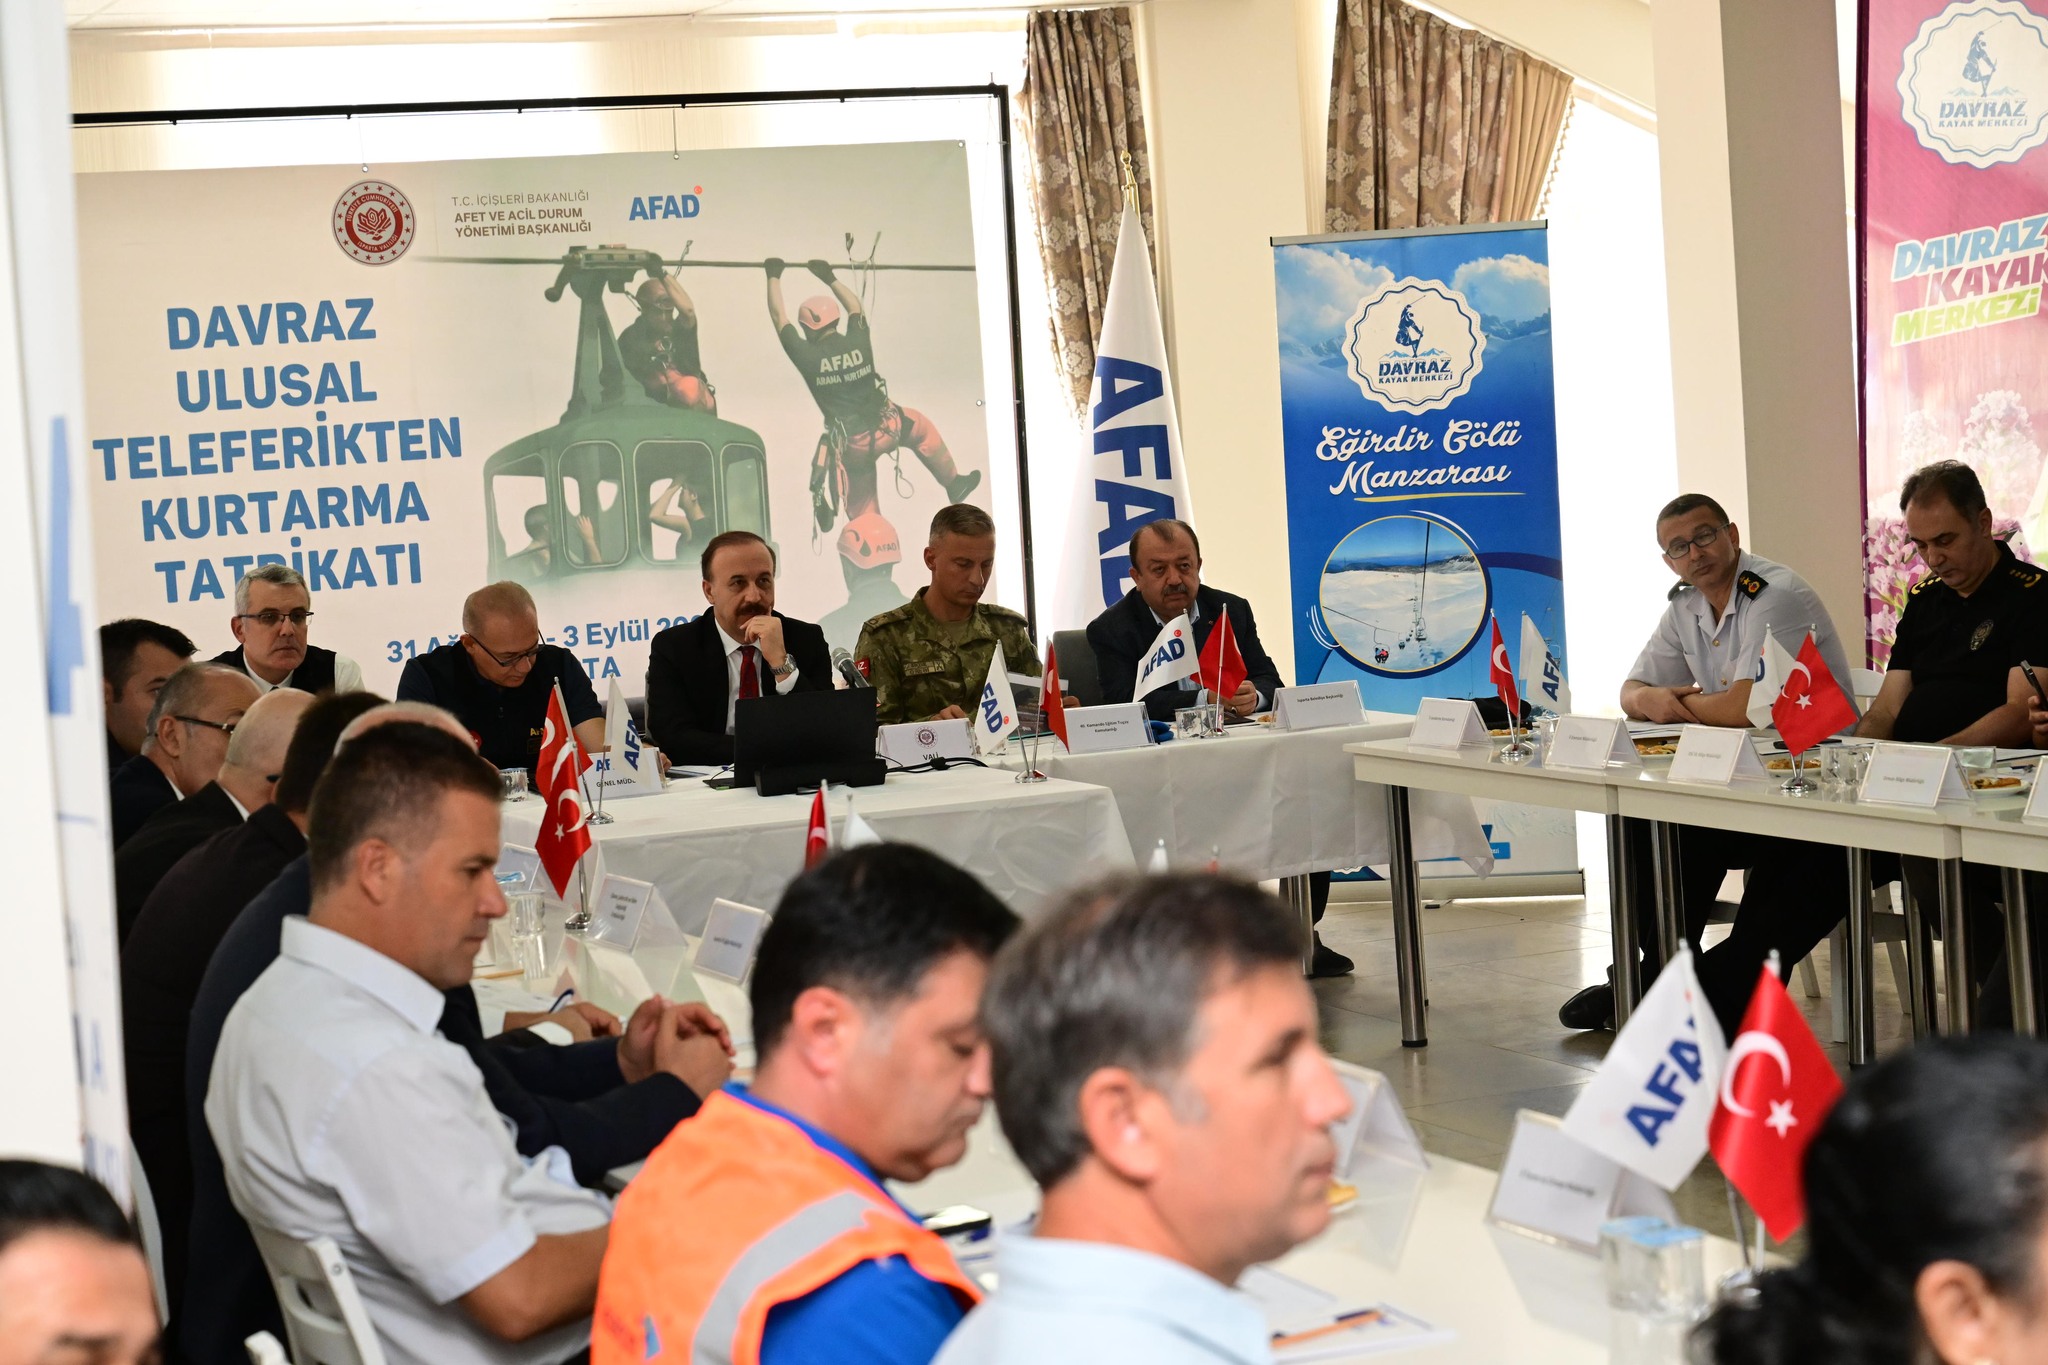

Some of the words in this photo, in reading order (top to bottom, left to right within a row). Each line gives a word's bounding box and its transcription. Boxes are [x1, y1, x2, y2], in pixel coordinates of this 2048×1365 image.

[1939, 99, 2028, 119] DAVRAZ
[1939, 119, 1975, 128] KAYAK
[451, 195, 474, 206] T.C.
[527, 189, 590, 204] BAKANLIĞI
[454, 211, 486, 224] AFET
[488, 210, 506, 222] VE
[507, 207, 536, 221] ACİL
[538, 207, 584, 220] DURUM
[628, 194, 701, 221] AFAD
[455, 223, 516, 238] YÖNETİMİ
[517, 220, 592, 237] BAŞKANLIĞI
[1893, 214, 2048, 280] DAVRAZ
[1927, 252, 2048, 307] KAYAK
[166, 297, 377, 350] DAVRAZ
[820, 349, 864, 373] AFAD
[1378, 357, 1453, 377] DAVRAZ
[1378, 376, 1409, 385] KAYAK
[1410, 372, 1453, 383] MERKEZİ
[176, 360, 378, 413] ULUSAL
[92, 410, 462, 482] TELEFERİKTEN
[1316, 424, 1434, 462] Eğirdir
[1442, 418, 1523, 455] Gölü
[1329, 460, 1512, 495] Manzarası
[141, 481, 430, 542] KURTARMA
[386, 639, 416, 663] 31
[563, 625, 579, 648] 3
[586, 618, 650, 649] Eylül
[1141, 637, 1186, 684] AFAD
[1541, 650, 1560, 702] AFA
[1625, 1015, 1703, 1147] AFA
